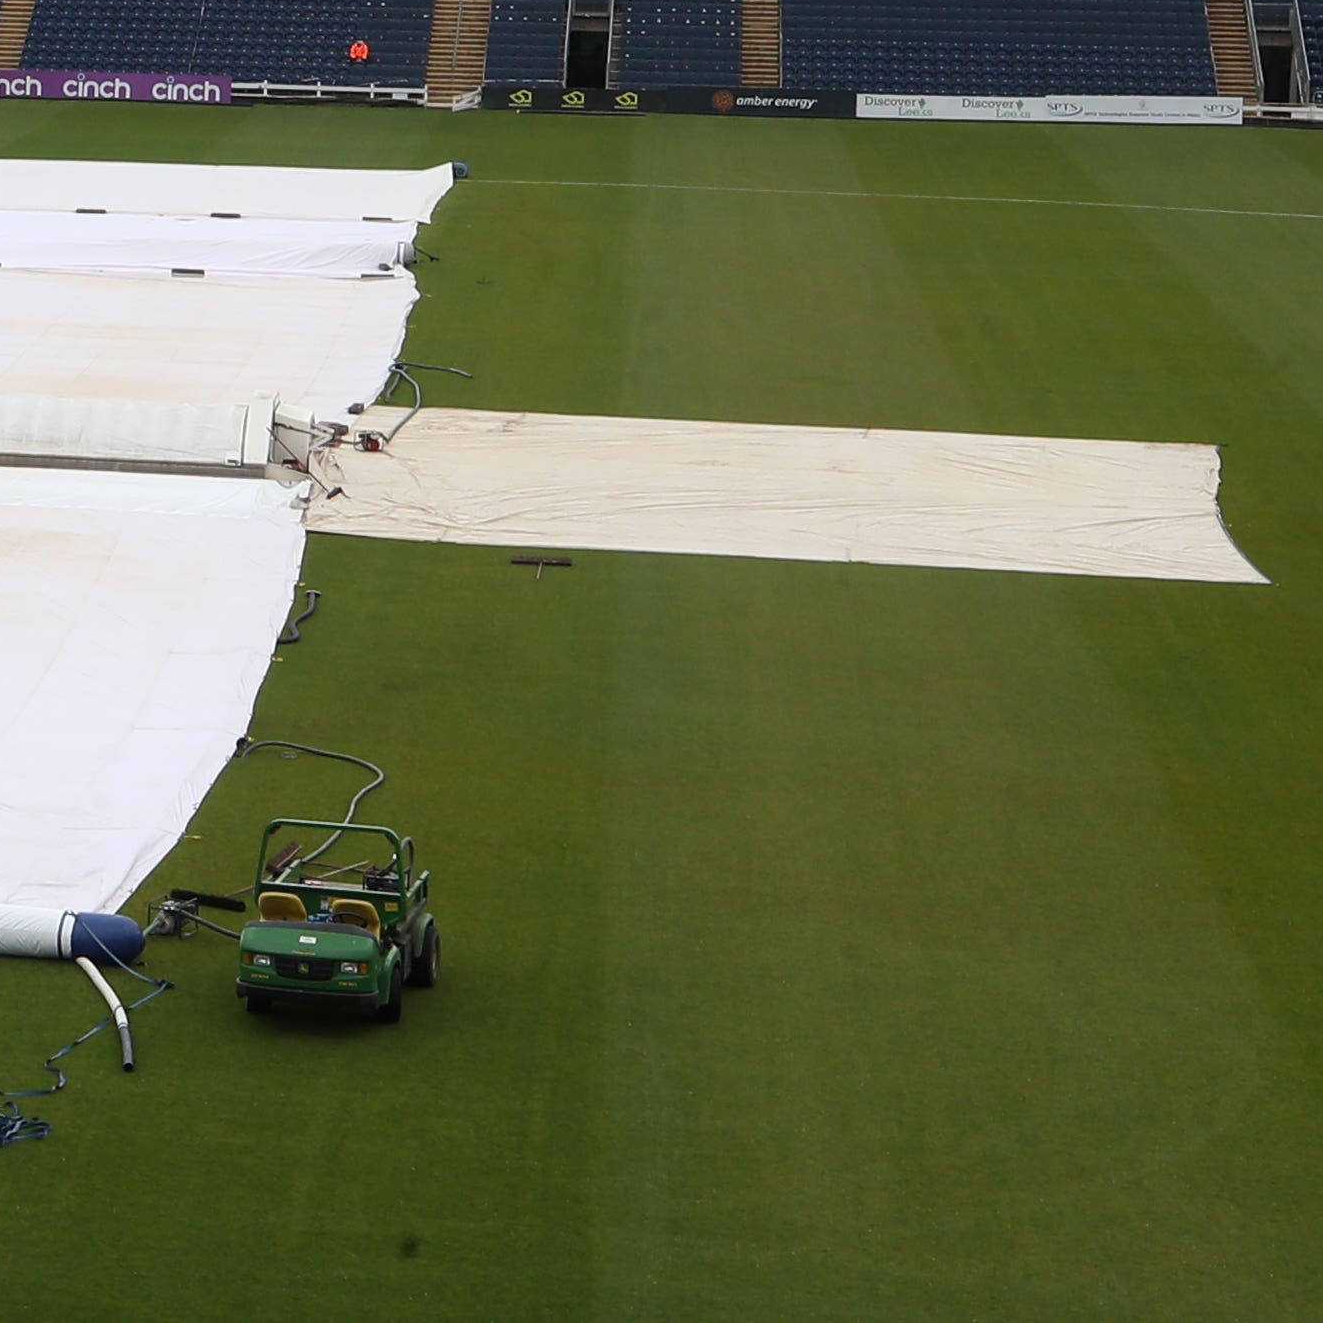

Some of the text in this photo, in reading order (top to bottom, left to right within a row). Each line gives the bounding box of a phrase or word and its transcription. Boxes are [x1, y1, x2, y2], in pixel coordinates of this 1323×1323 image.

[62, 73, 131, 99] cinch
[152, 76, 221, 102] cinch
[736, 95, 815, 109] amber energy
[865, 96, 917, 107] Discover
[962, 98, 1014, 109] Discover
[1047, 102, 1078, 112] SPTS
[1203, 104, 1235, 113] SPTS
